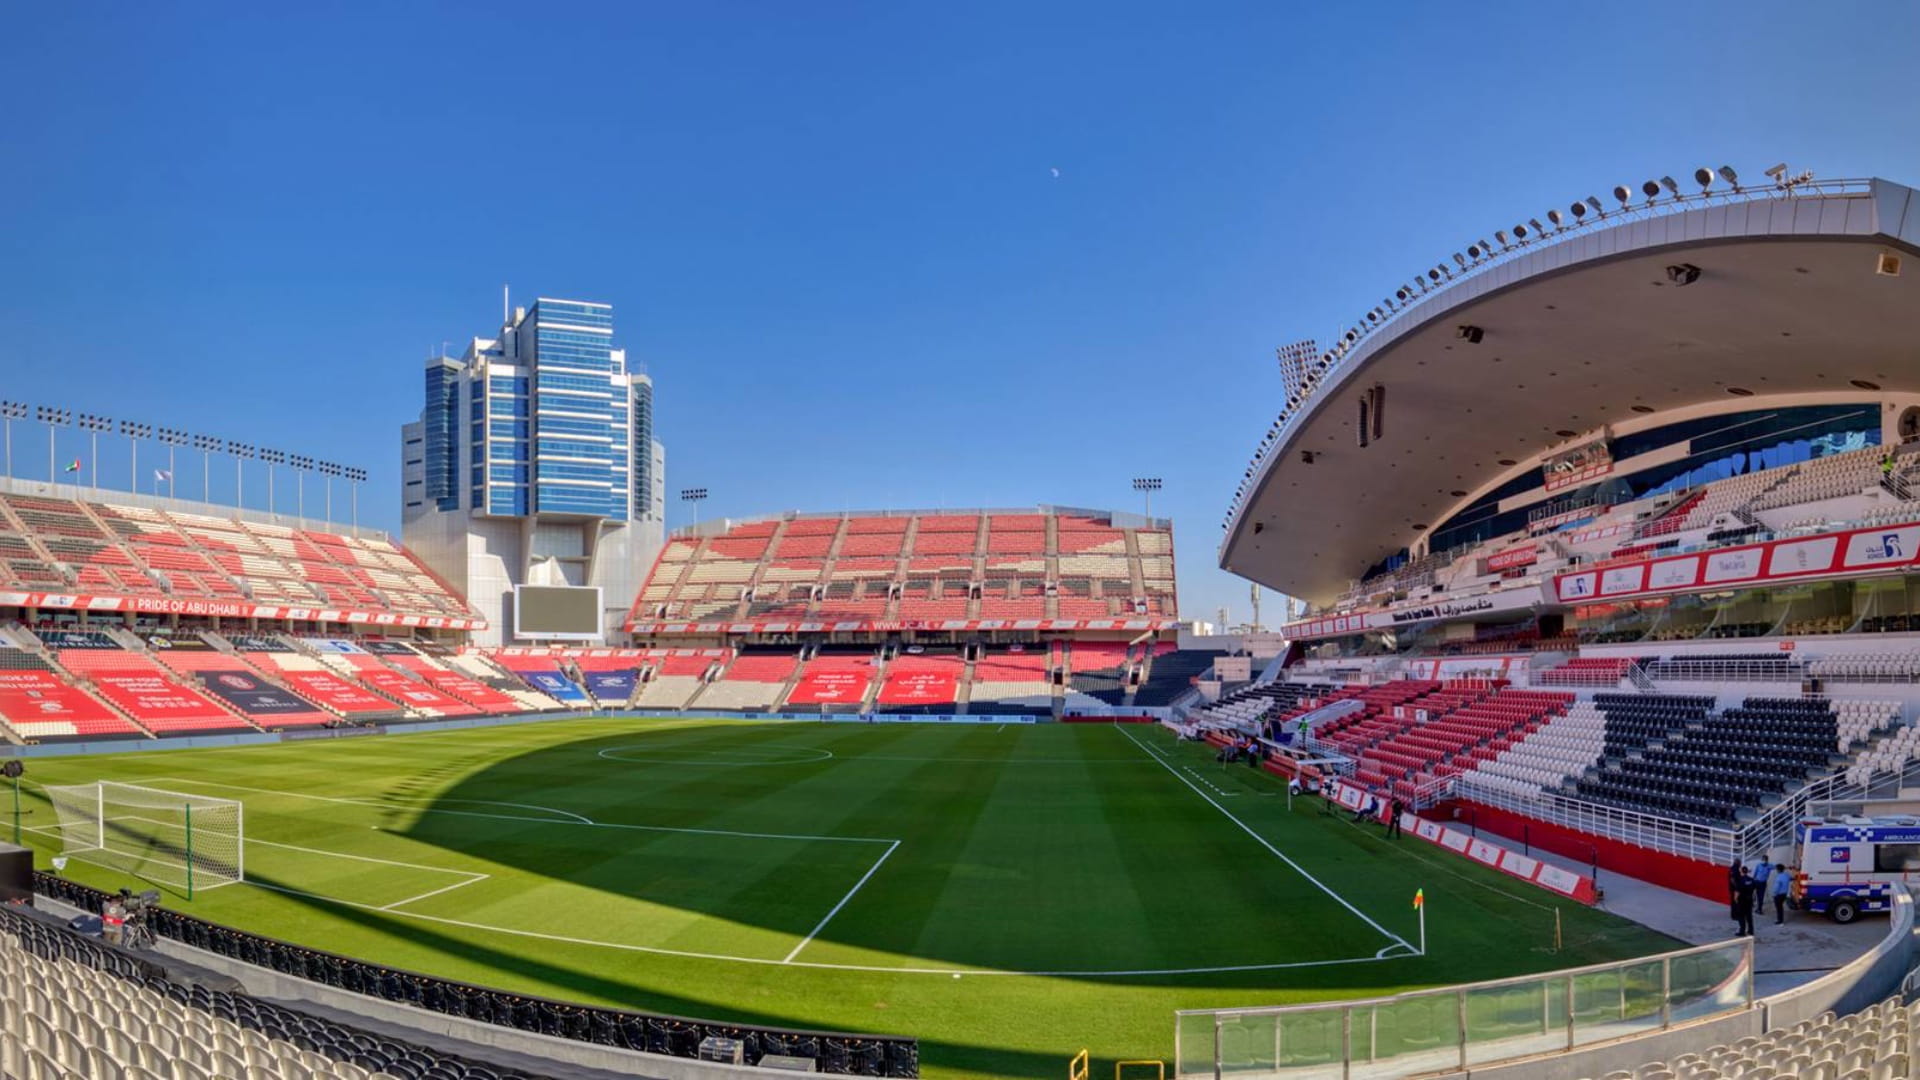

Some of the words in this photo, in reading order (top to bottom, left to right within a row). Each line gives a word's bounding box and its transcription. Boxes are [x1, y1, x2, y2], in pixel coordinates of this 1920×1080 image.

[138, 599, 169, 611] PRIDE
[170, 601, 186, 612] OF
[186, 603, 208, 613] ABU
[209, 605, 240, 615] DHABI
